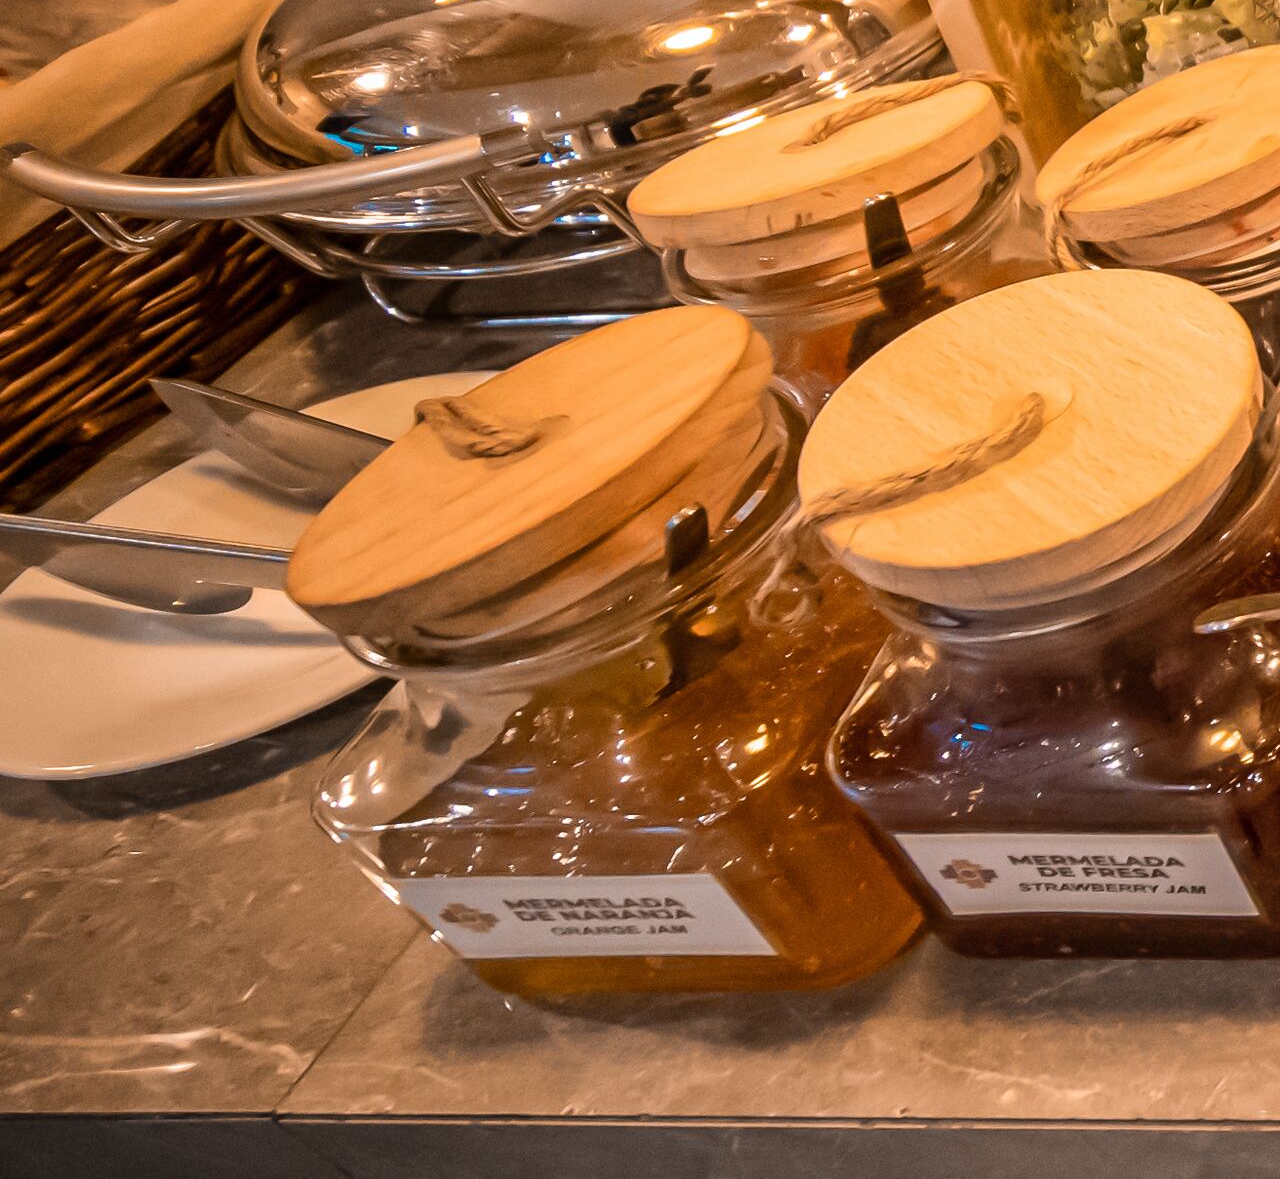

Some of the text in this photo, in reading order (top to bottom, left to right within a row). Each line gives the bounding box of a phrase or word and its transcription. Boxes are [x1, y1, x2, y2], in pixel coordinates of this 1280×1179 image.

[1006, 854, 1185, 868] MERMELADA
[1036, 866, 1170, 879] DE FRESA
[1018, 882, 1207, 895] STRAWBERRY JAM
[502, 897, 685, 910] MERMELADA
[514, 909, 696, 921] DE NARANJA
